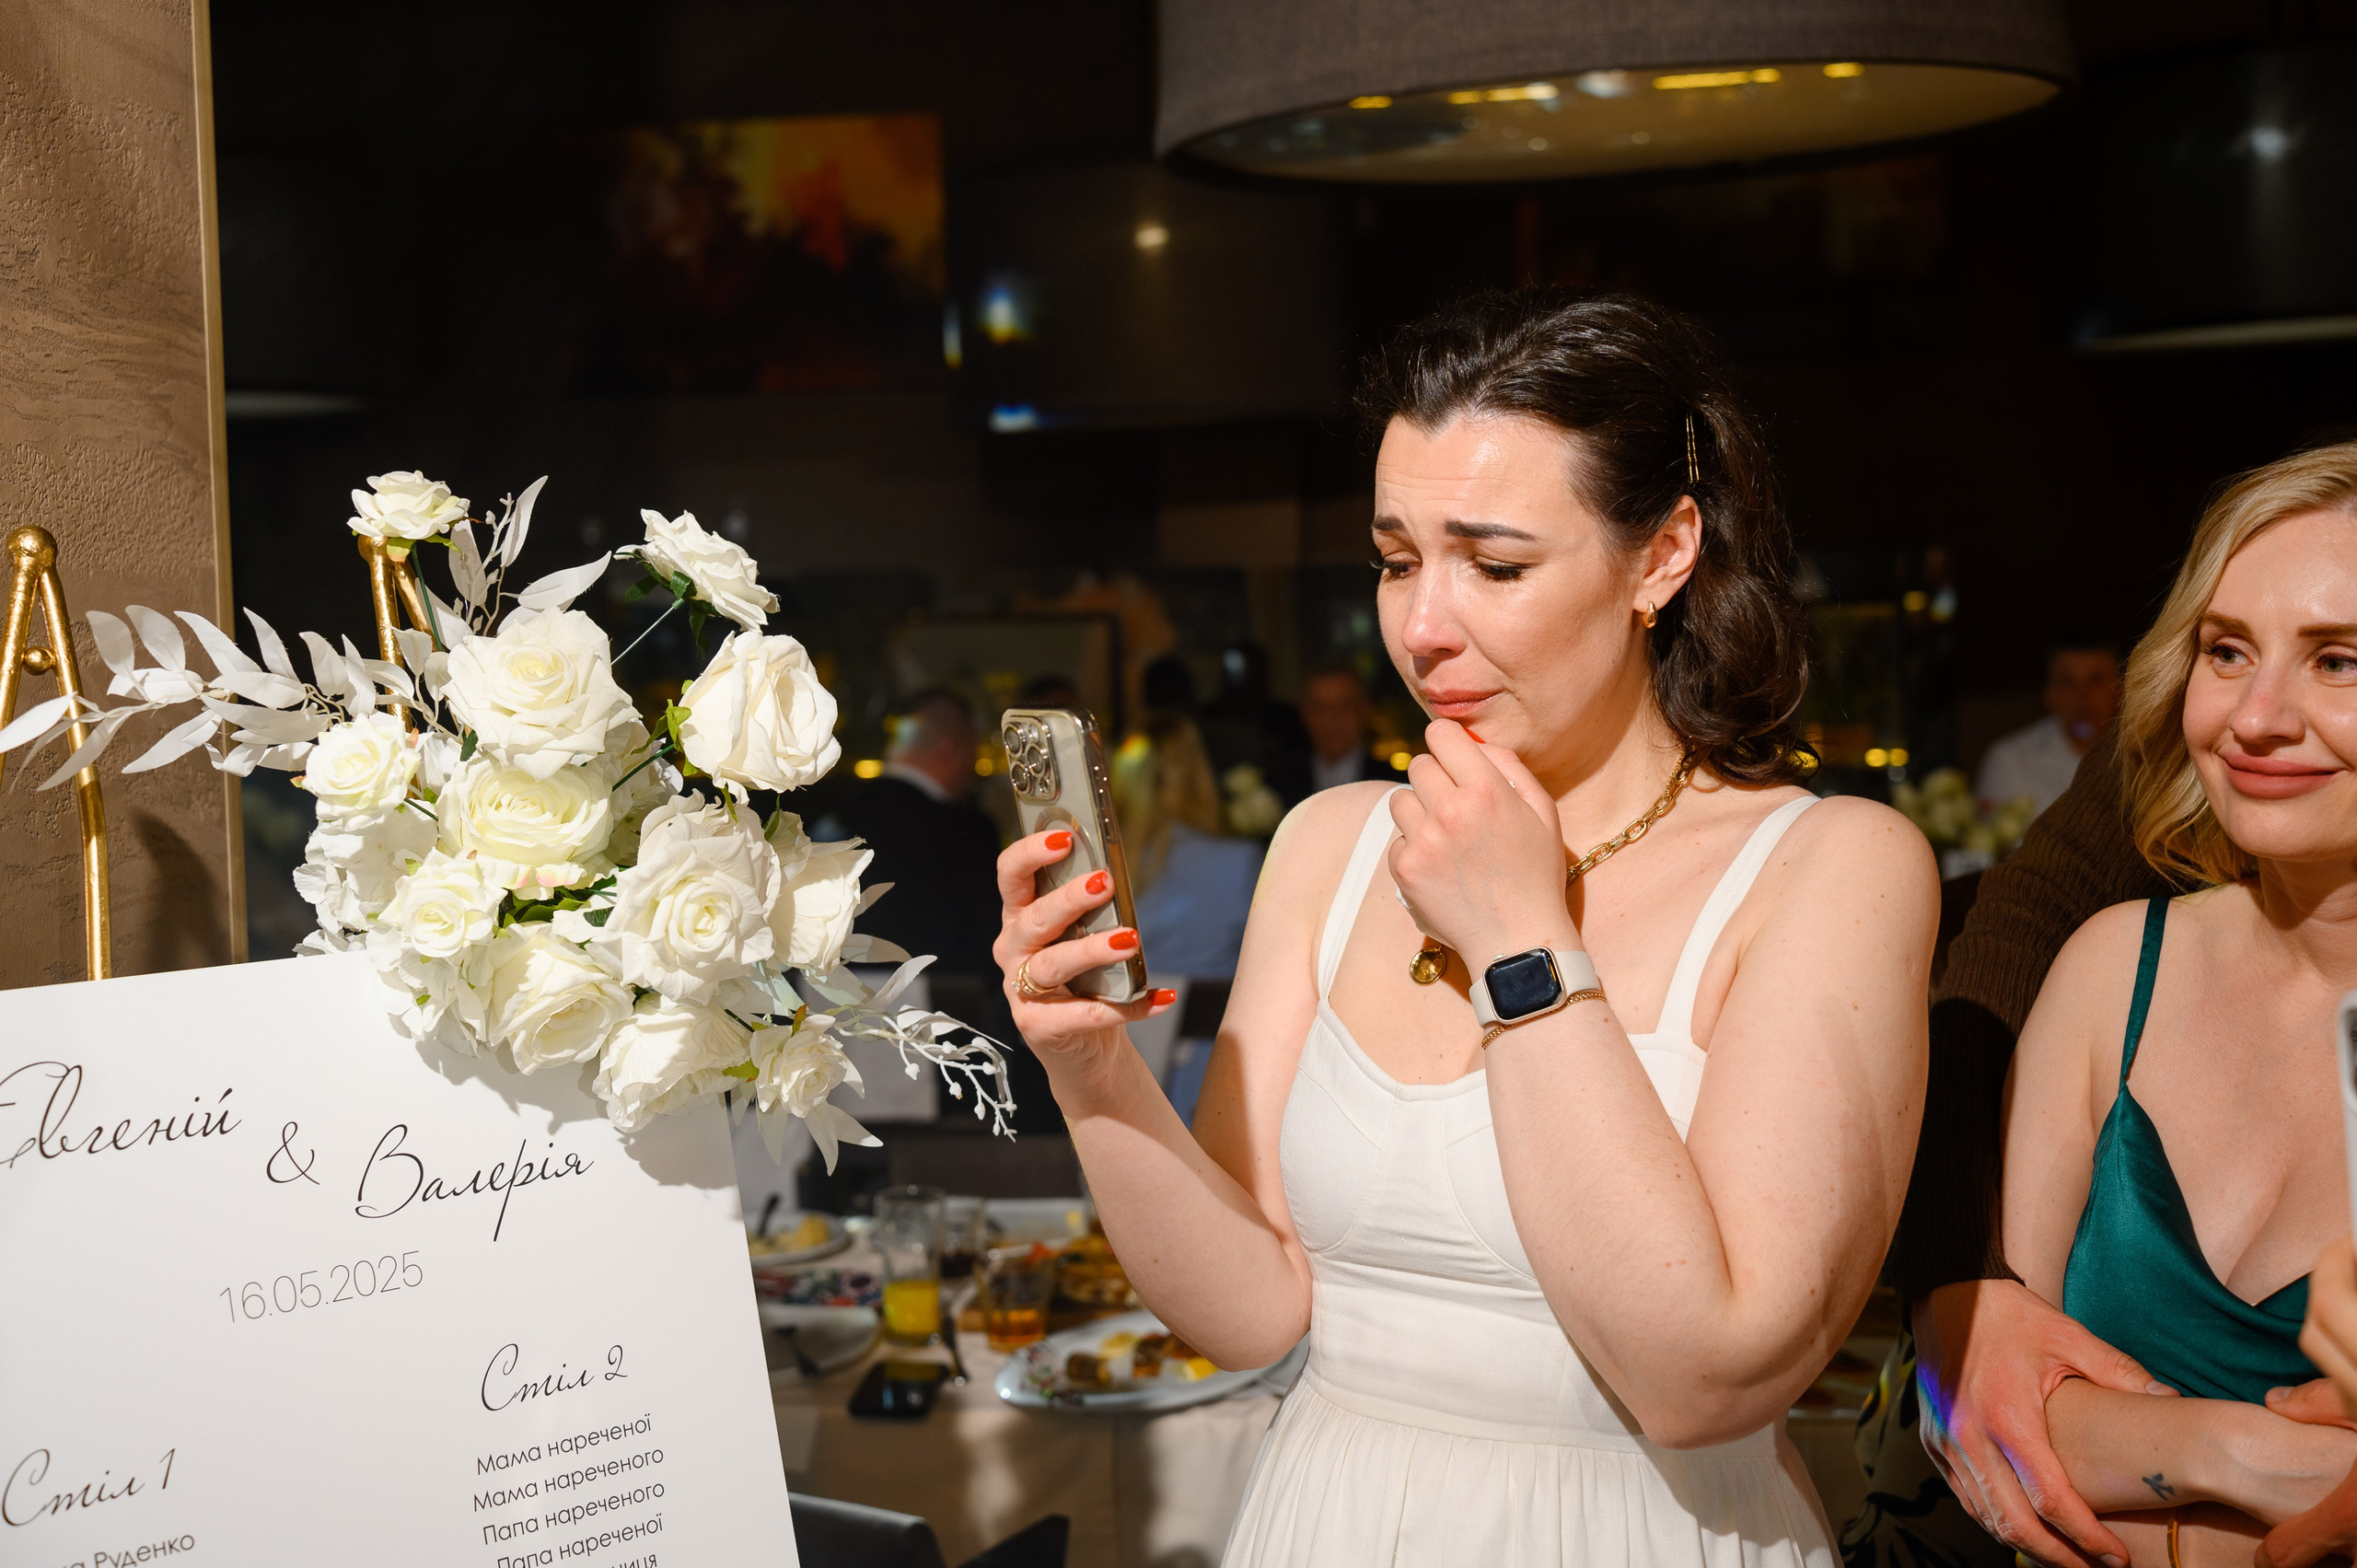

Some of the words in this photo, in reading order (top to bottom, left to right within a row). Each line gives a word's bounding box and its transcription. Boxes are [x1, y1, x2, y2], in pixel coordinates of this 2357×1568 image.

[265, 1121, 319, 1185] &
[354, 1123, 595, 1242] Валерія
[219, 1249, 424, 1323] 16.05.2025
[481, 1343, 595, 1411] Стіл
[604, 1344, 629, 1381] 2
[477, 1446, 542, 1476] Мама
[548, 1413, 652, 1457] нареченої
[2, 1448, 145, 1527] Стіл
[159, 1448, 176, 1490] 1
[473, 1481, 539, 1512] Мама
[544, 1449, 664, 1493] нареченого
[482, 1517, 540, 1545] Папа
[545, 1483, 665, 1528] нареченого
[559, 1513, 663, 1560] нареченої
[94, 1535, 195, 1568] Руденко
